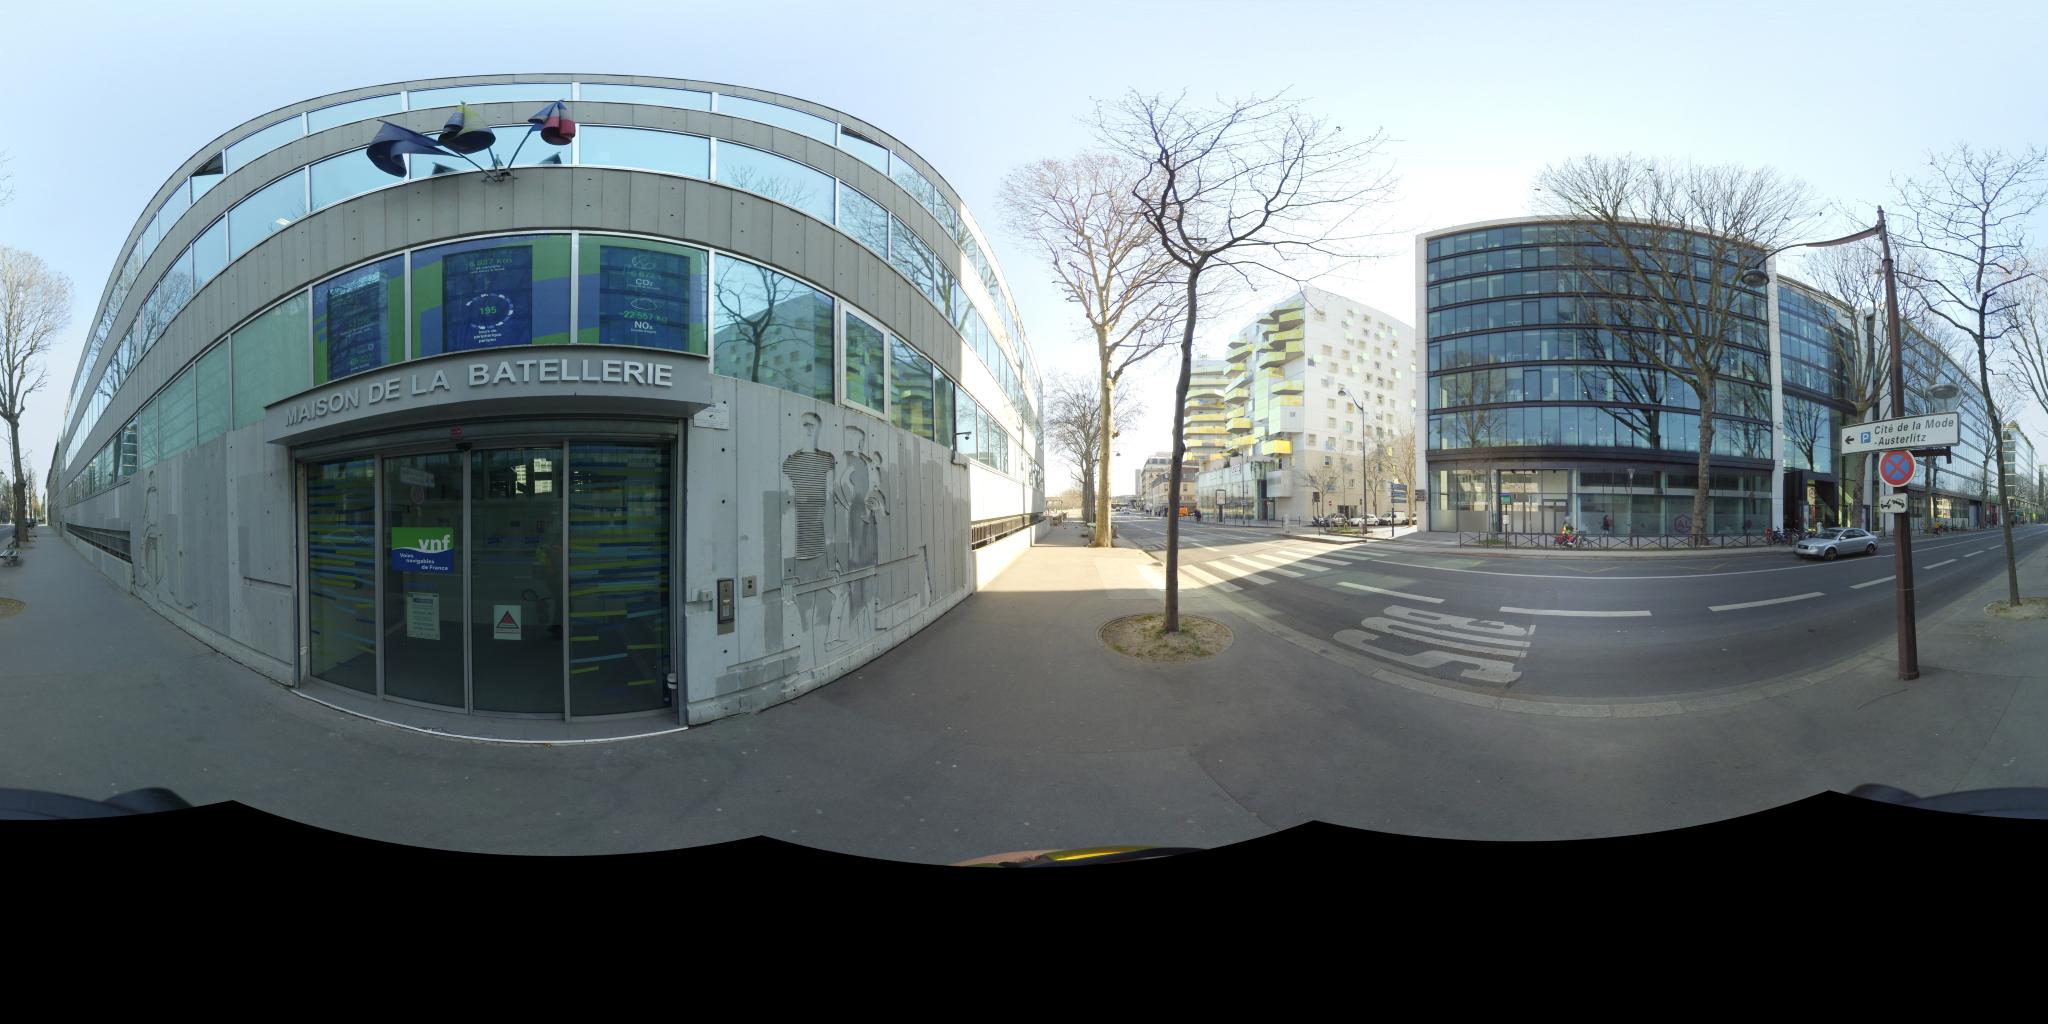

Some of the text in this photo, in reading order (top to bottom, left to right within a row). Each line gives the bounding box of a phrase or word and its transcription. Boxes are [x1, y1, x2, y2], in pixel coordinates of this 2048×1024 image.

[480, 305, 497, 315] 195
[285, 358, 673, 427] MAISON DE LA BATELLERIE
[1874, 418, 1954, 435] Cité de la Mode
[419, 534, 451, 553] vnf
[1333, 604, 1536, 683] BUS
